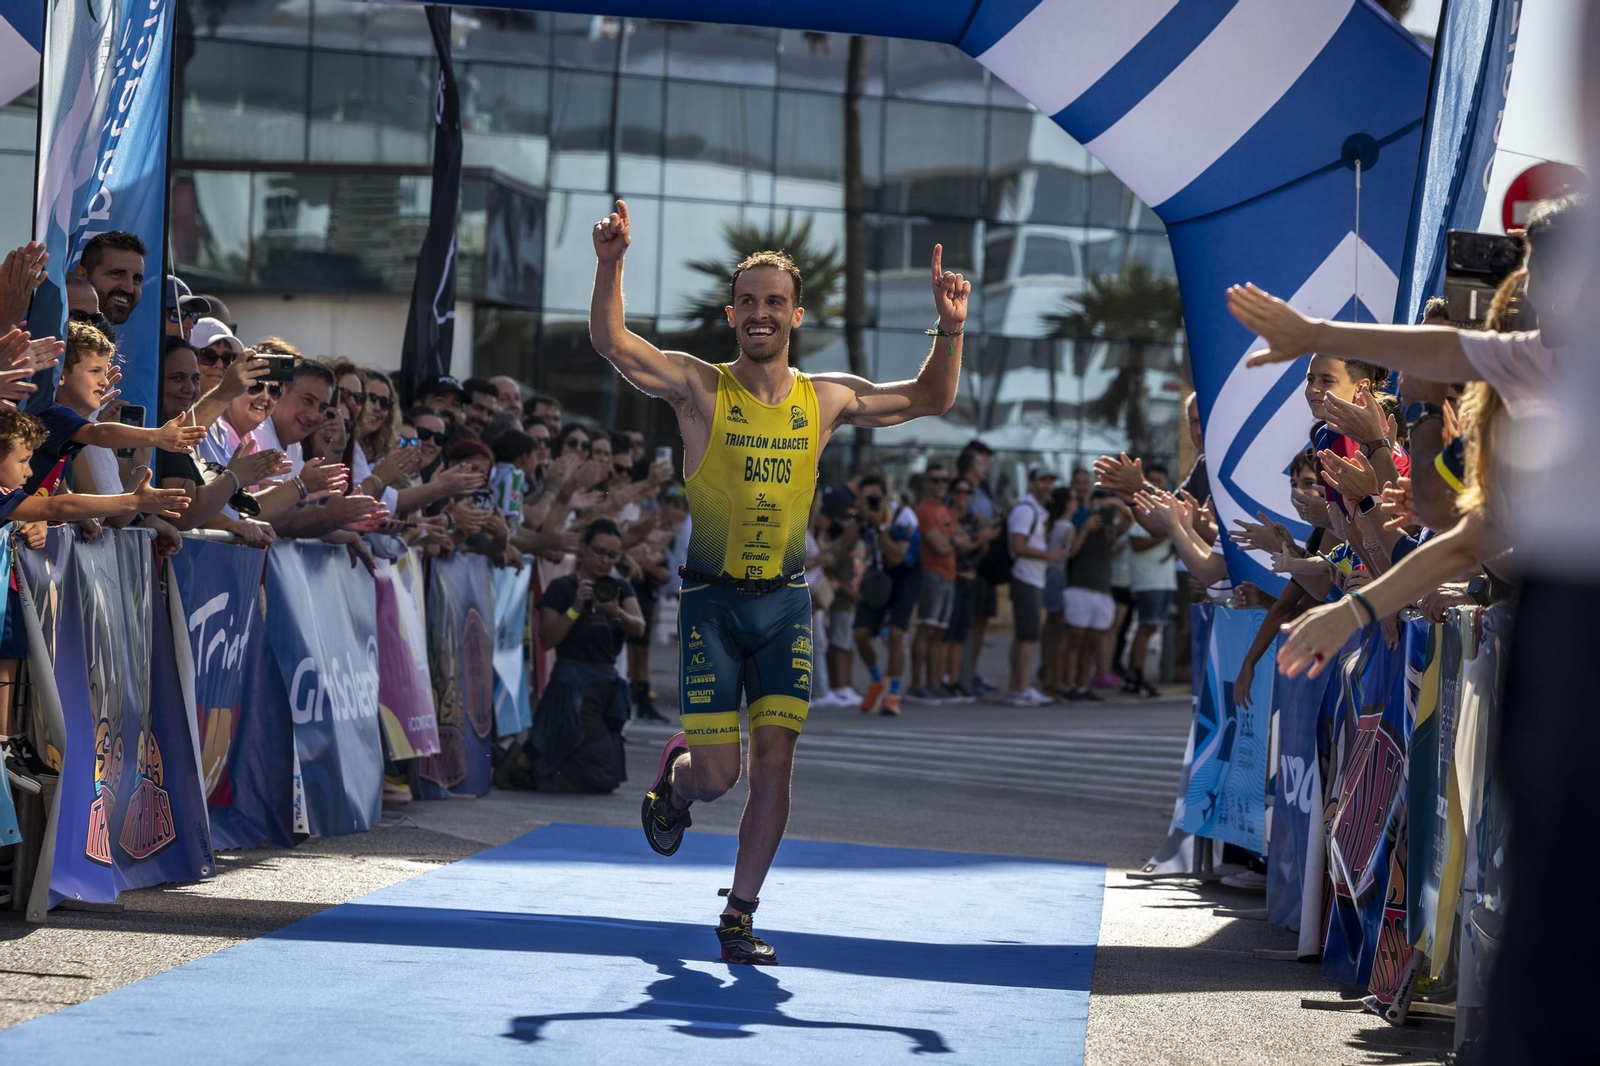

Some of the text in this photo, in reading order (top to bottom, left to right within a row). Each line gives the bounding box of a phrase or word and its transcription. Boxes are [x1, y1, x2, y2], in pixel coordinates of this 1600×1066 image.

[725, 432, 809, 450] TRIATLÓN ALBACETE
[744, 456, 792, 484] BASTOS
